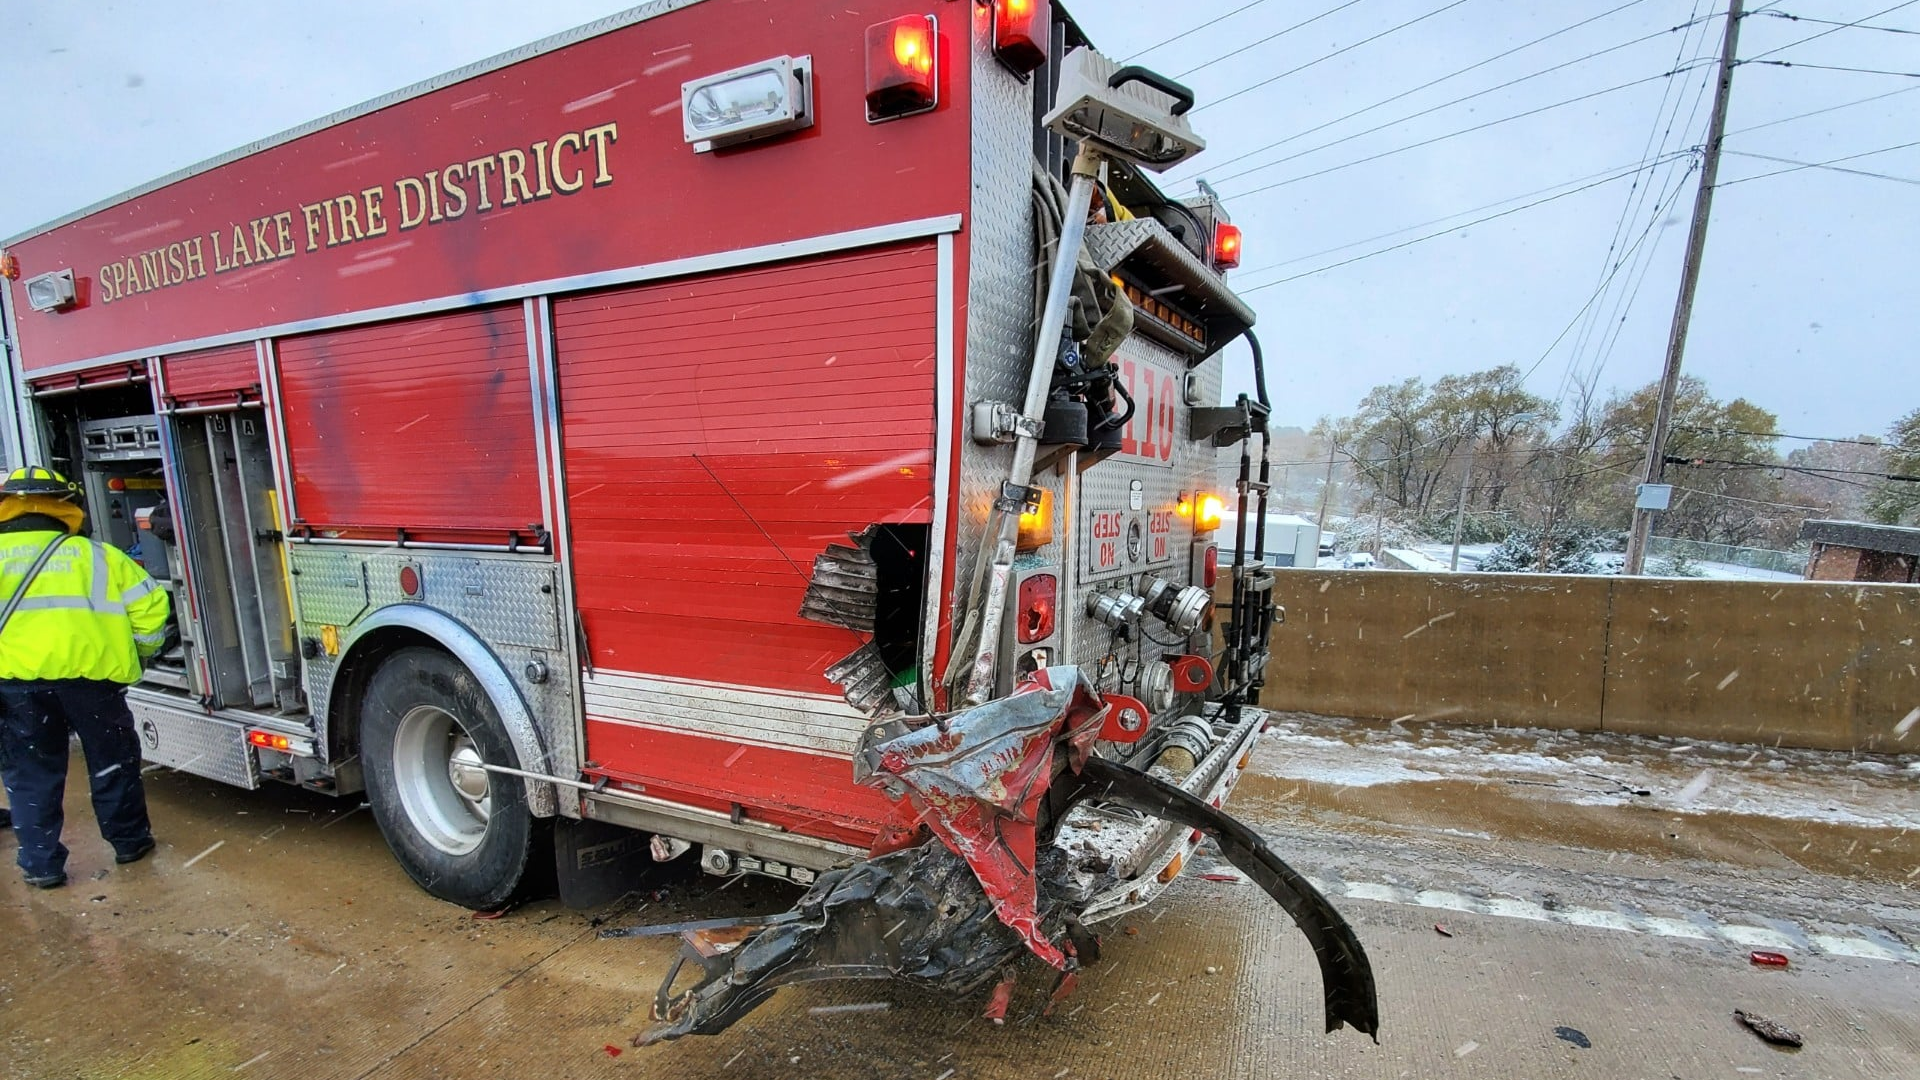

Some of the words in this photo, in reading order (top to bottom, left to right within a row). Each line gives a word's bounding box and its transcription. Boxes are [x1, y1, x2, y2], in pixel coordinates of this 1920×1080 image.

[99, 236, 206, 304] SPANISH
[209, 210, 296, 274] LAKE
[303, 184, 389, 252] FIRE
[395, 122, 618, 231] DISTRICT
[1094, 513, 1121, 538] STEP
[1150, 511, 1171, 533] STEP
[1100, 541, 1115, 567] NO
[1153, 536, 1166, 558] NO
